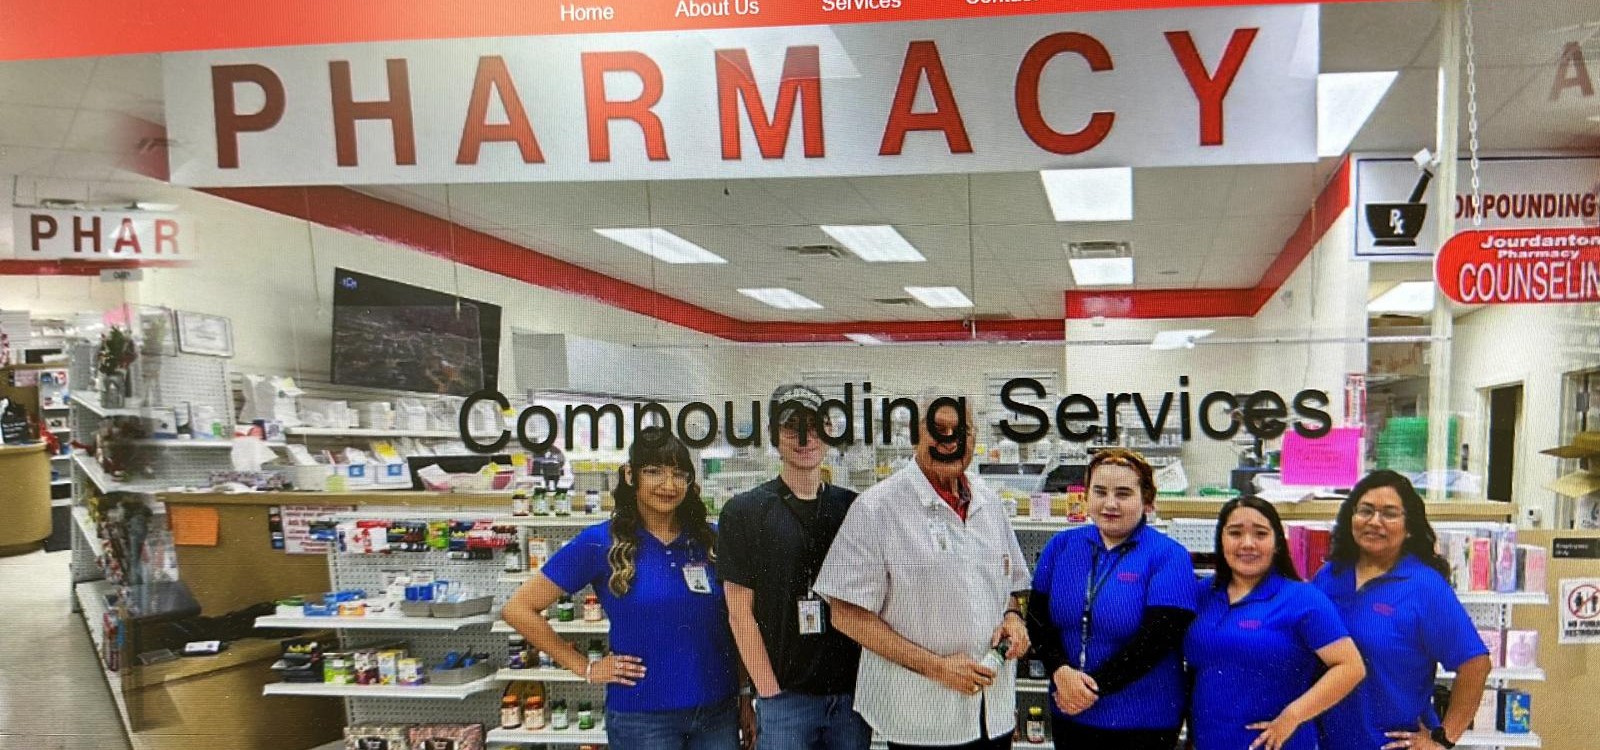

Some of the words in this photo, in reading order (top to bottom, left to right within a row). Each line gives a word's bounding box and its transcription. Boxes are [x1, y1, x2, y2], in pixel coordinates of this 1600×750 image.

[560, 4, 615, 22] Home
[674, 0, 730, 18] About
[734, 0, 760, 15] Us
[821, 0, 902, 11] Services
[210, 26, 1259, 170] PHARMACY
[1455, 193, 1597, 219] OMPOUNDING
[1497, 249, 1580, 260] Pharmacy
[458, 381, 967, 463] Compounding
[999, 375, 1333, 444] Services
